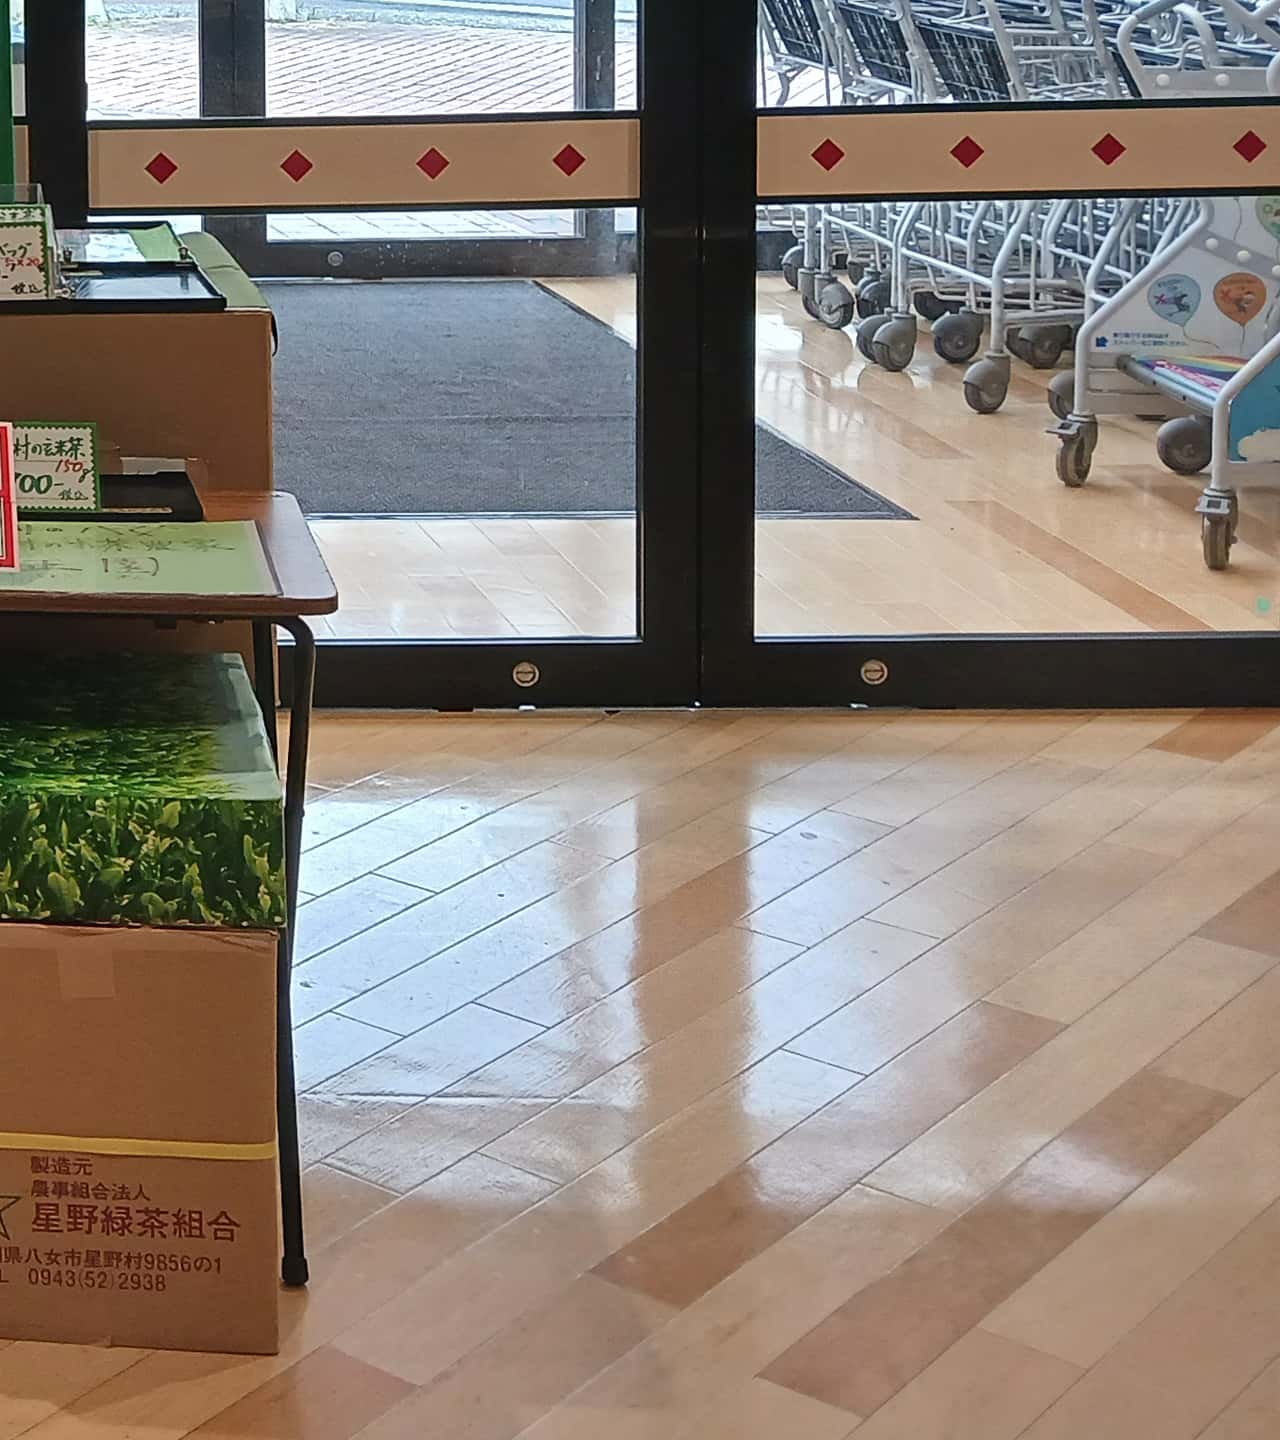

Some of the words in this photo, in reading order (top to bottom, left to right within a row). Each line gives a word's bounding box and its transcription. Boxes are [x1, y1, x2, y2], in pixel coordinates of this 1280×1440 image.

[30, 1156, 93, 1177] 製造元
[30, 1180, 151, 1202] 農事組合法人
[31, 1203, 242, 1242] 星野緑茶組合
[27, 1269, 167, 1293] 0943(52)2938
